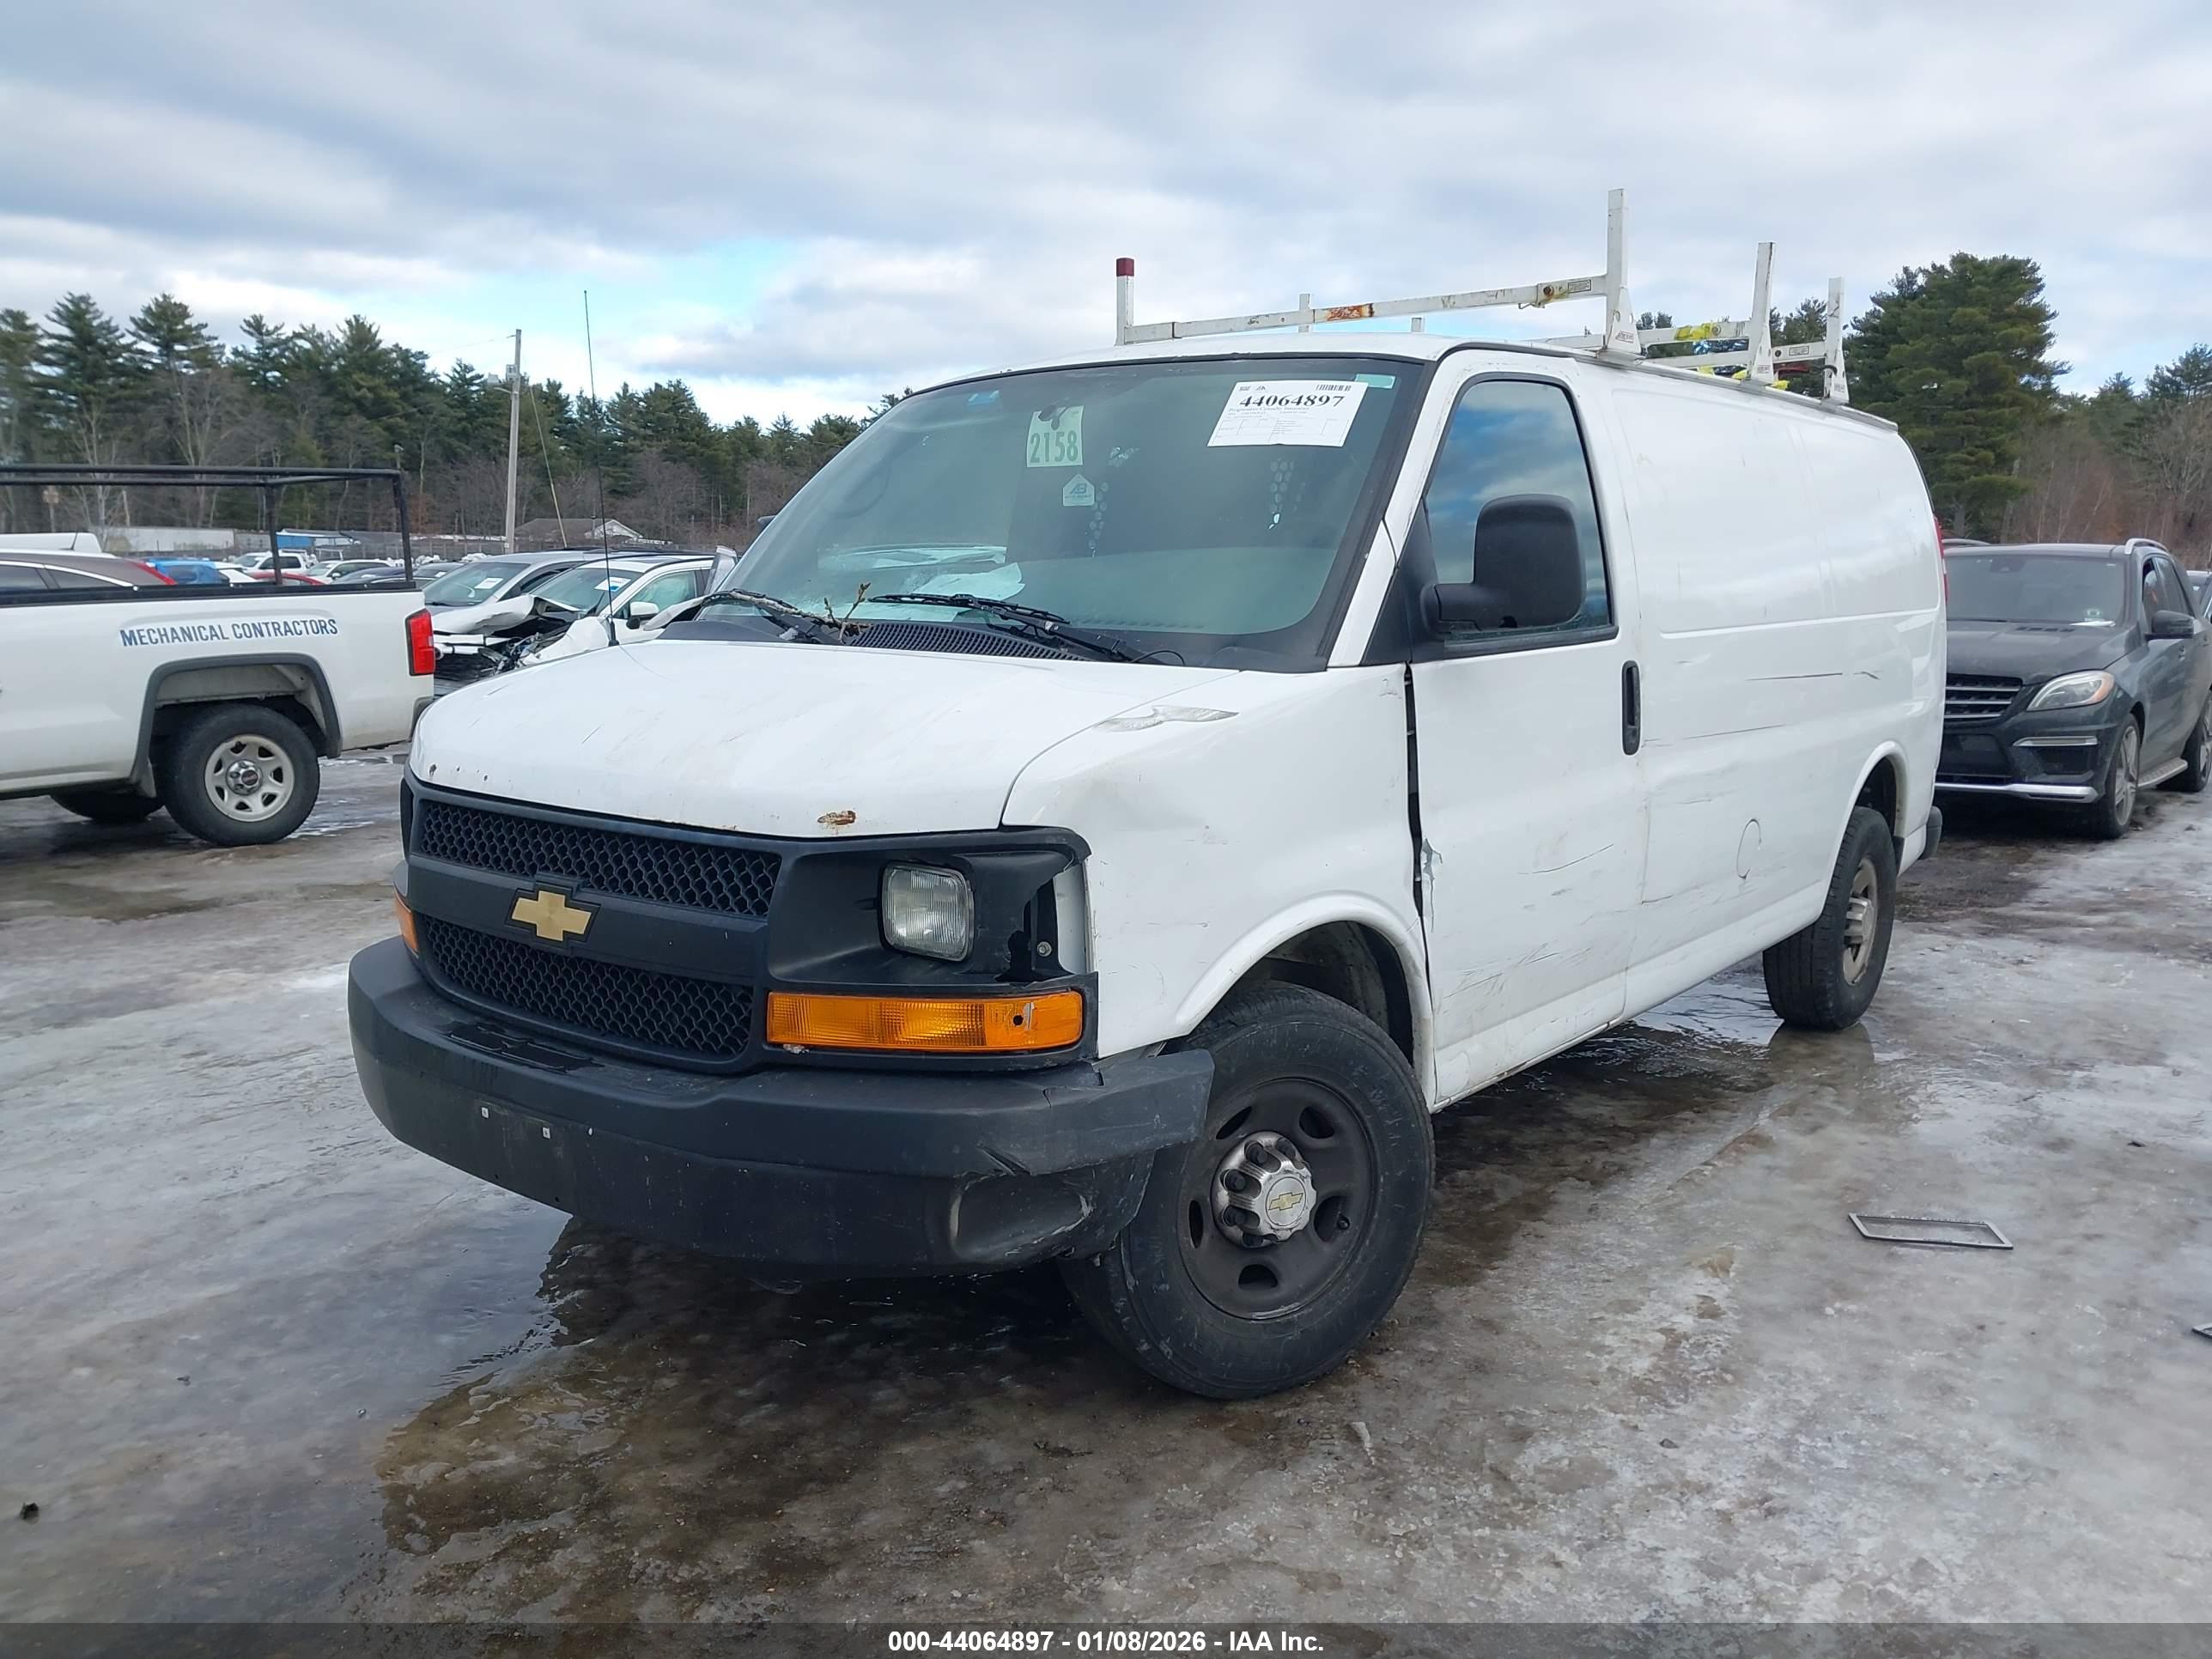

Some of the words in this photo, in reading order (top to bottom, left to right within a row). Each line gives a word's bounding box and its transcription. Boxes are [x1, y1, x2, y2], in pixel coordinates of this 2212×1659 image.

[1239, 394, 1346, 408] 44064897
[1030, 430, 1079, 464] 2158
[119, 623, 229, 647] MECHANICAL
[232, 618, 338, 640] CONTRACTORS
